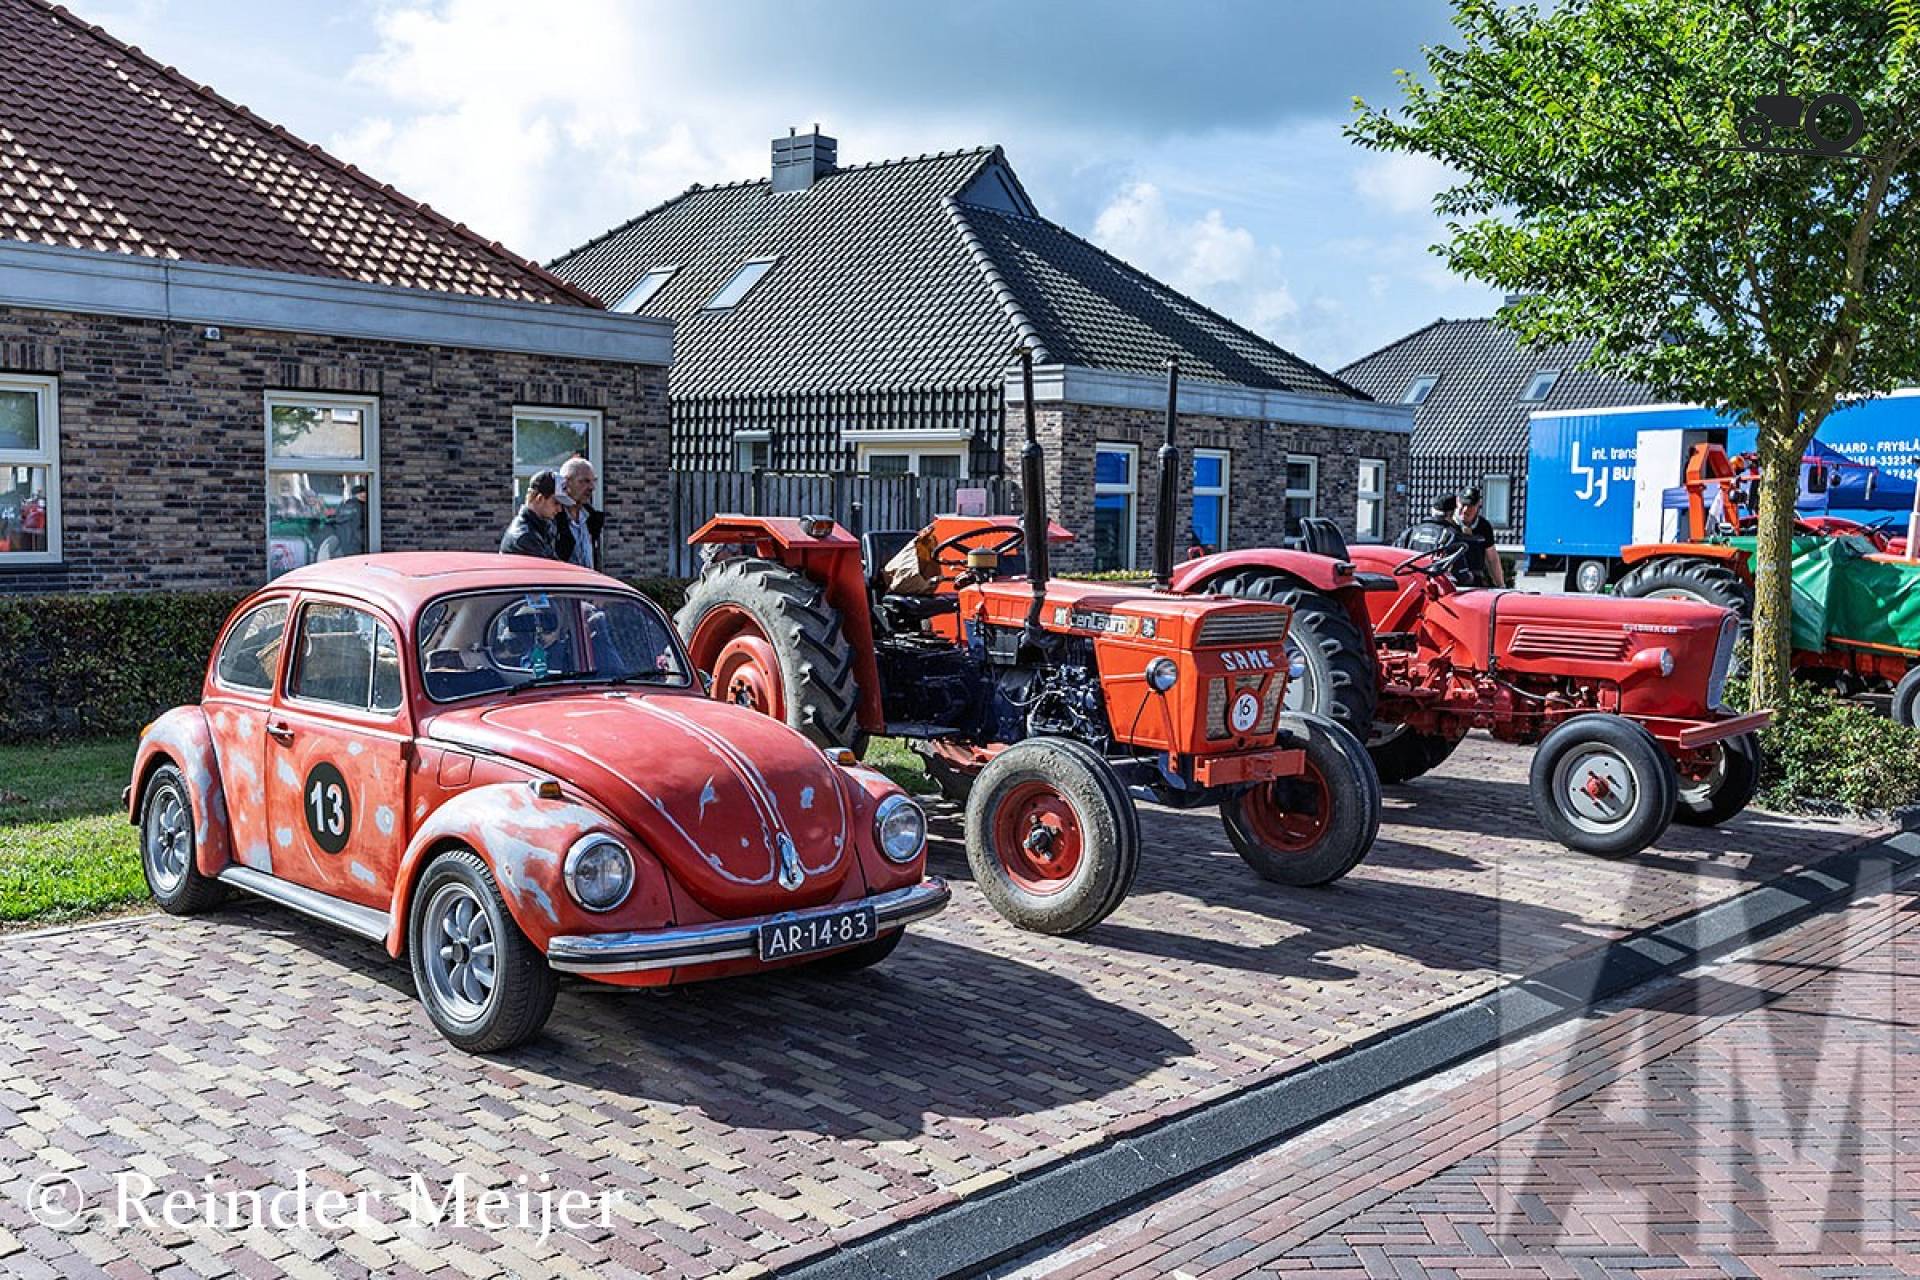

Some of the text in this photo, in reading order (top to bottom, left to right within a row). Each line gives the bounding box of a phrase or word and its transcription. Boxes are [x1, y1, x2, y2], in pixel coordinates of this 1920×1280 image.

[1613, 466, 1637, 481] BU
[1220, 649, 1275, 671] SAME
[310, 781, 345, 836] 13
[769, 913, 869, 956] AR-14-83
